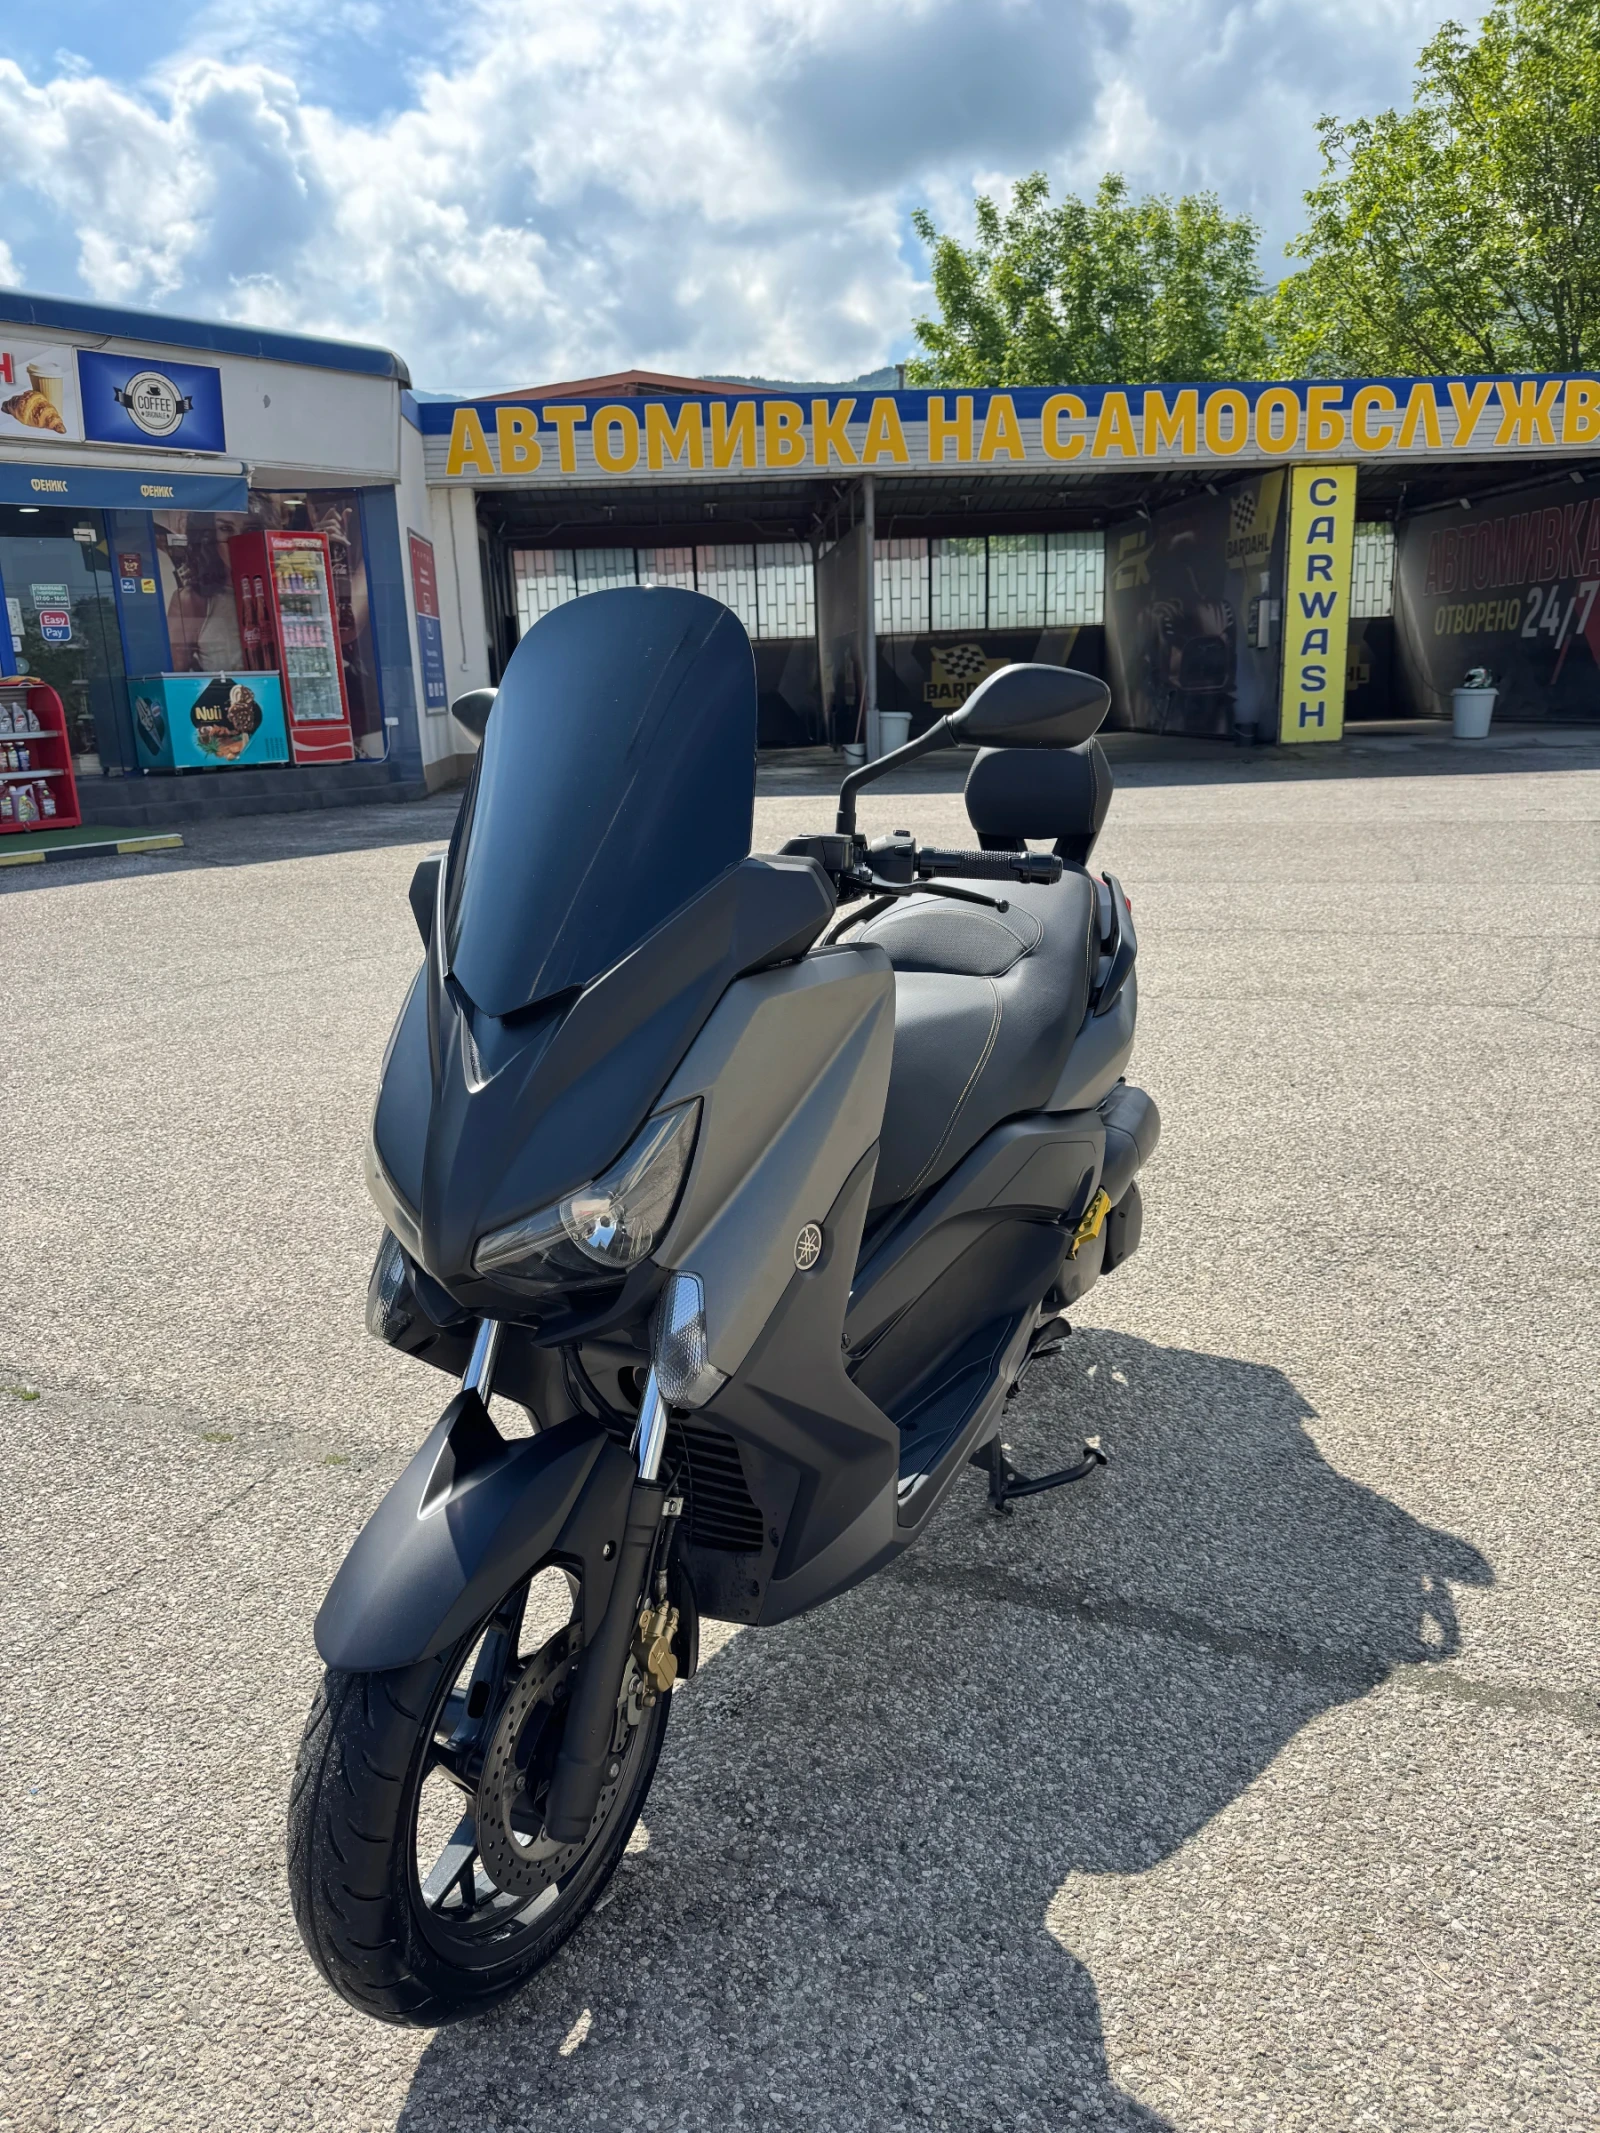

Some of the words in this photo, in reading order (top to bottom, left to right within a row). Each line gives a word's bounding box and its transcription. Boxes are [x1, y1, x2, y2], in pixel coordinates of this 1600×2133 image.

[137, 395, 172, 412] COFFEE
[446, 397, 911, 476] АВТОМИВКА
[927, 394, 1026, 464] НА
[1041, 379, 1600, 461] САМООБСЛУЖВ
[30, 478, 68, 493] ФЕНИКС
[140, 484, 174, 498] ФЕНИКС
[1227, 532, 1270, 560] BARDAHL
[1422, 498, 1600, 597] АВТОМИВКА
[44, 615, 66, 625] Easy
[1434, 598, 1521, 636] ОТВОРЕНО
[1521, 580, 1600, 649] 24/7
[46, 628, 63, 638] Pay
